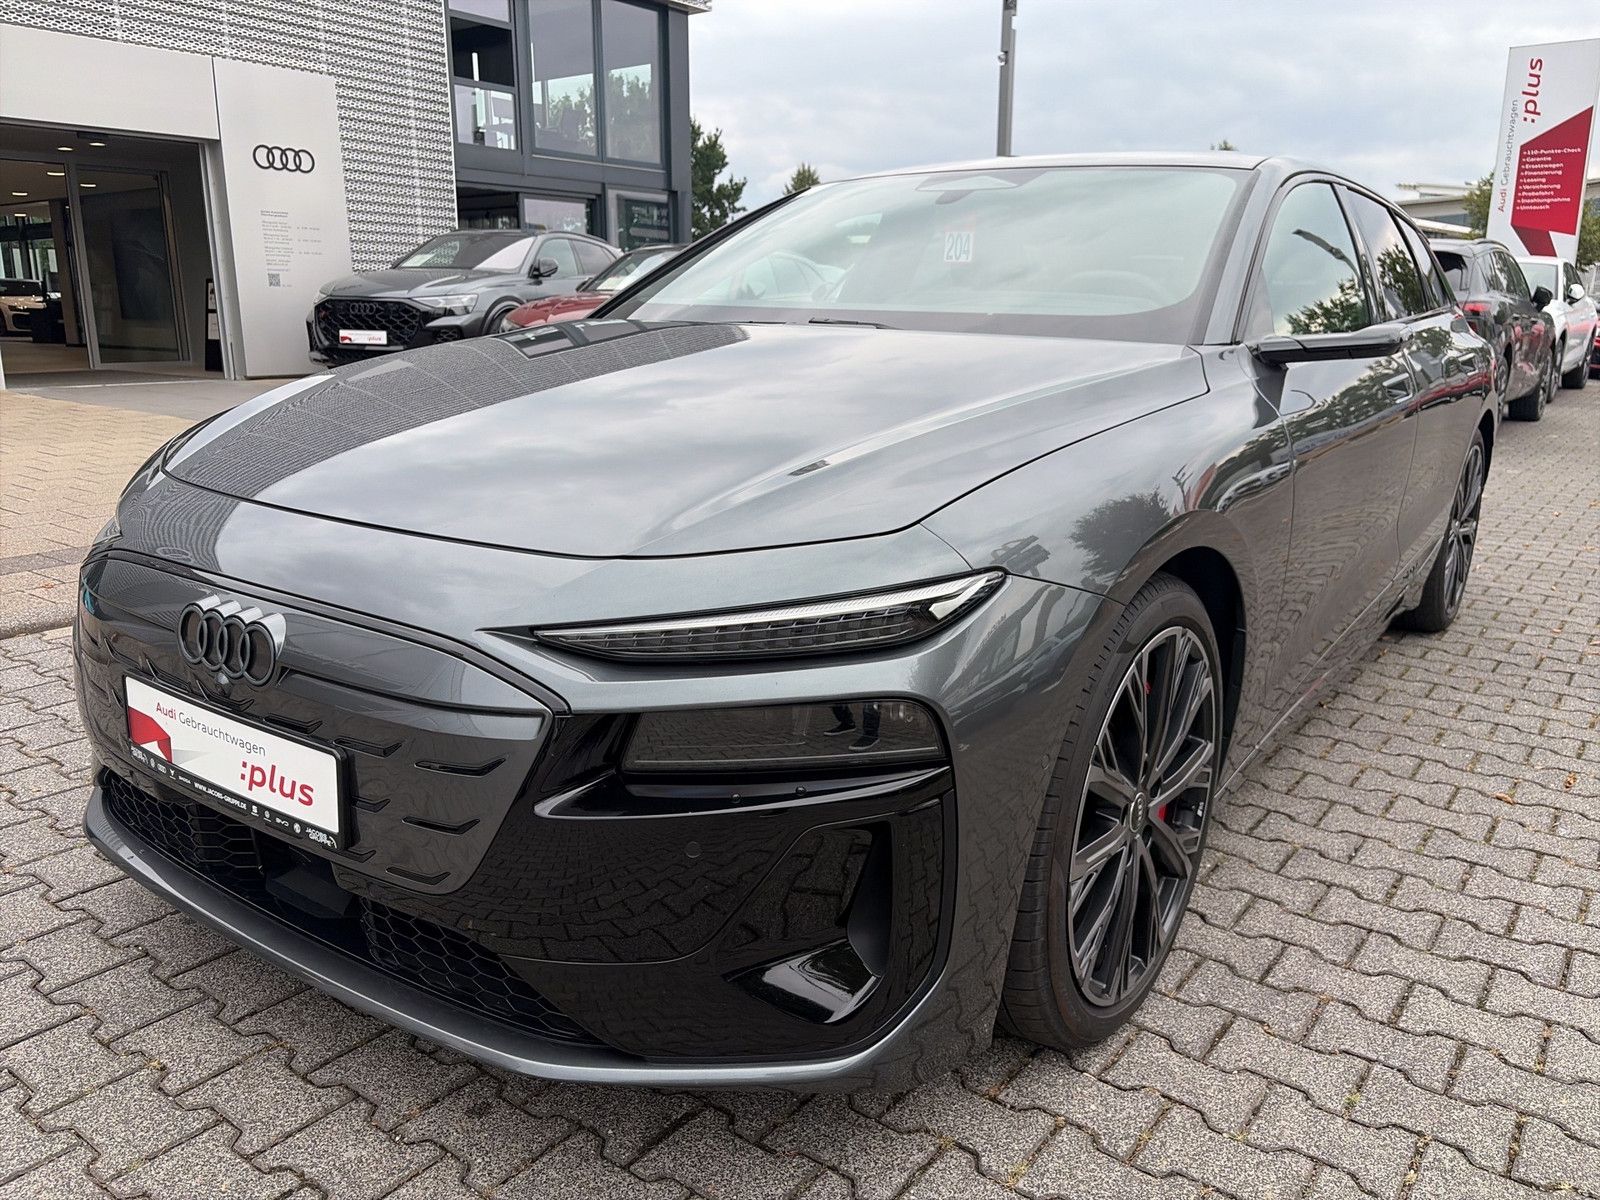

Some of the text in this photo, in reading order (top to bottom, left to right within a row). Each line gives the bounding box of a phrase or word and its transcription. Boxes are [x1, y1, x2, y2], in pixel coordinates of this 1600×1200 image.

[1521, 58, 1543, 123] :plus
[1498, 99, 1518, 212] Audi Gebrauchtwagen
[946, 233, 971, 260] 204
[156, 702, 177, 720] Audi
[178, 712, 266, 757] Gebrauchtwagen
[240, 761, 314, 806] :plus
